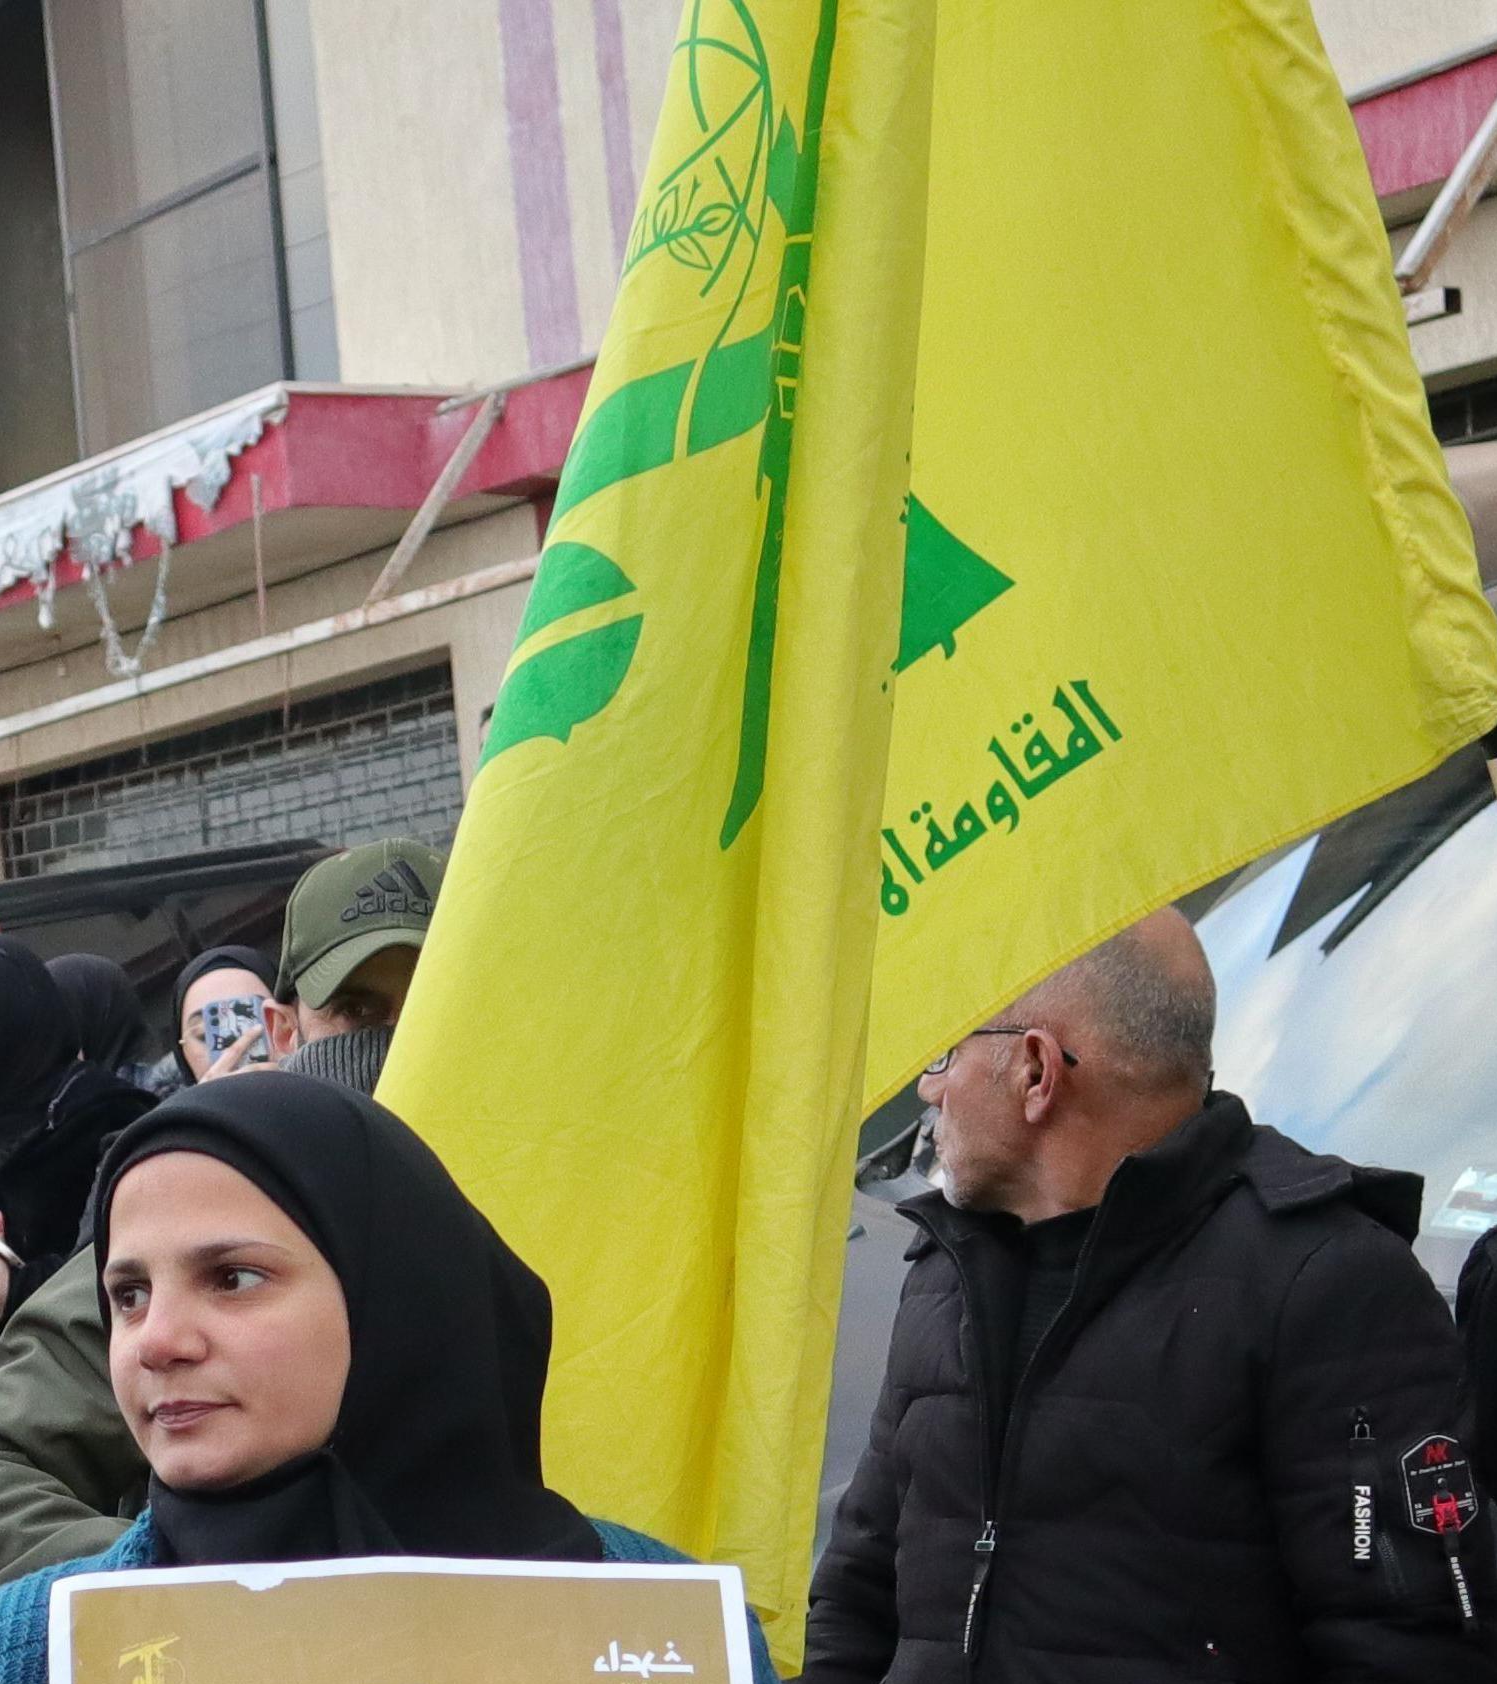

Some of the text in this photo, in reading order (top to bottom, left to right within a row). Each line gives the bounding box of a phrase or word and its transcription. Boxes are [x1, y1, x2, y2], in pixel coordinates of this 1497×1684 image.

[909, 679, 1123, 872] المقاومة
[340, 892, 432, 922] adida
[1353, 1485, 1372, 1560] FASHION
